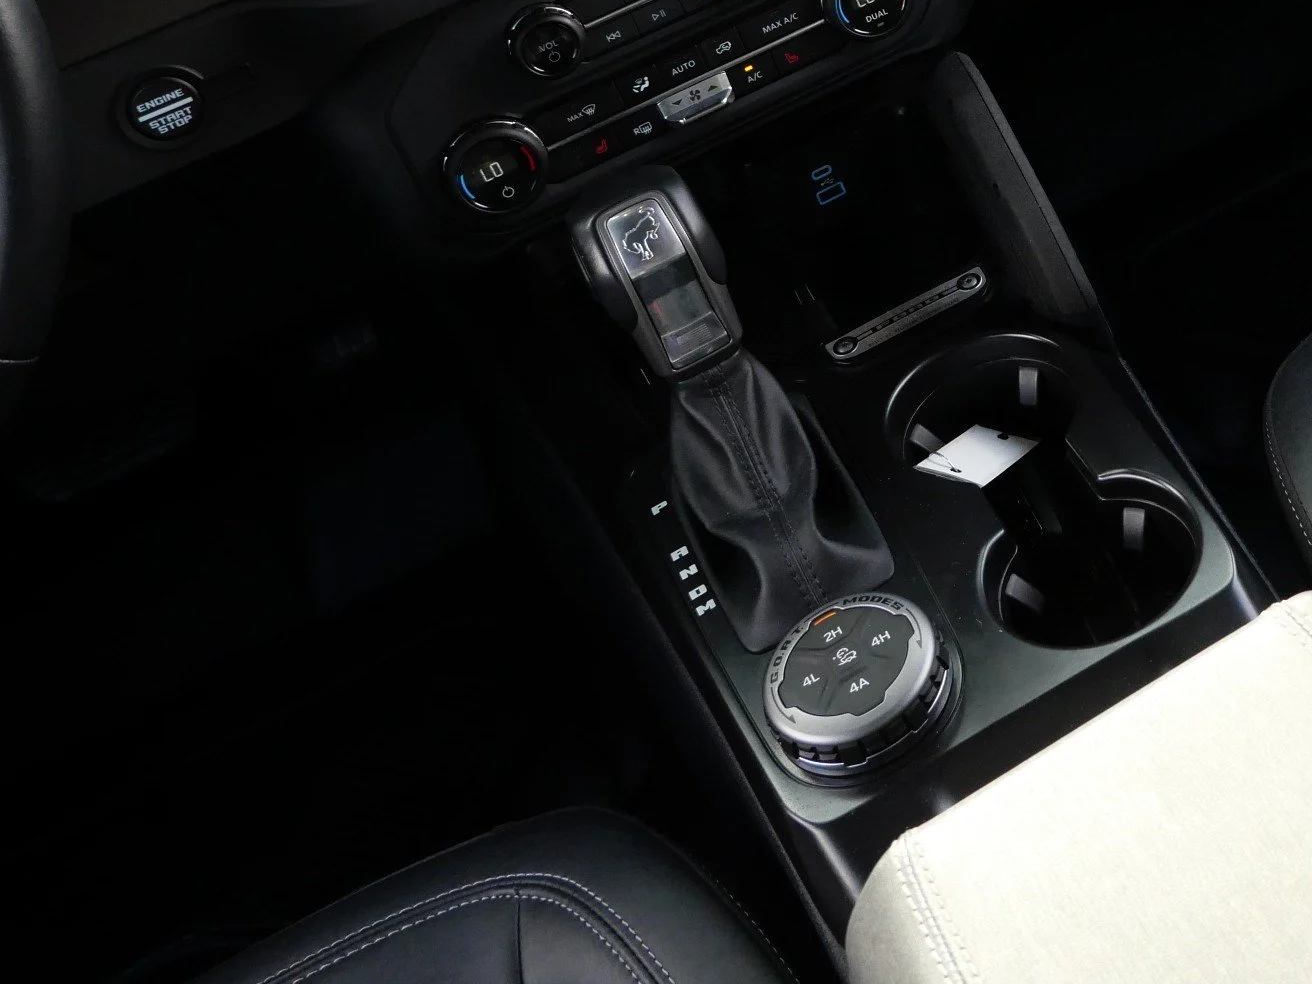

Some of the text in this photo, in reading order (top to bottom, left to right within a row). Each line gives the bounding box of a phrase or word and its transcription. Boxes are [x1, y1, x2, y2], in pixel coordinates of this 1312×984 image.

[762, 12, 799, 34] MAX A/C
[865, 8, 889, 24] DUAL
[538, 40, 559, 53] VOL
[671, 60, 696, 76] AUTO
[747, 71, 763, 83] A/C
[136, 88, 185, 113] ENGINE
[149, 106, 192, 130] START
[158, 114, 193, 135] STOP
[566, 110, 583, 123] MAX
[651, 500, 668, 516] P
[679, 563, 699, 580] N
[695, 598, 717, 617] M
[842, 595, 904, 611] MODES
[823, 626, 843, 643] 2H
[871, 630, 891, 647] 4H
[802, 673, 820, 687] 4L
[849, 677, 870, 693] 4A
